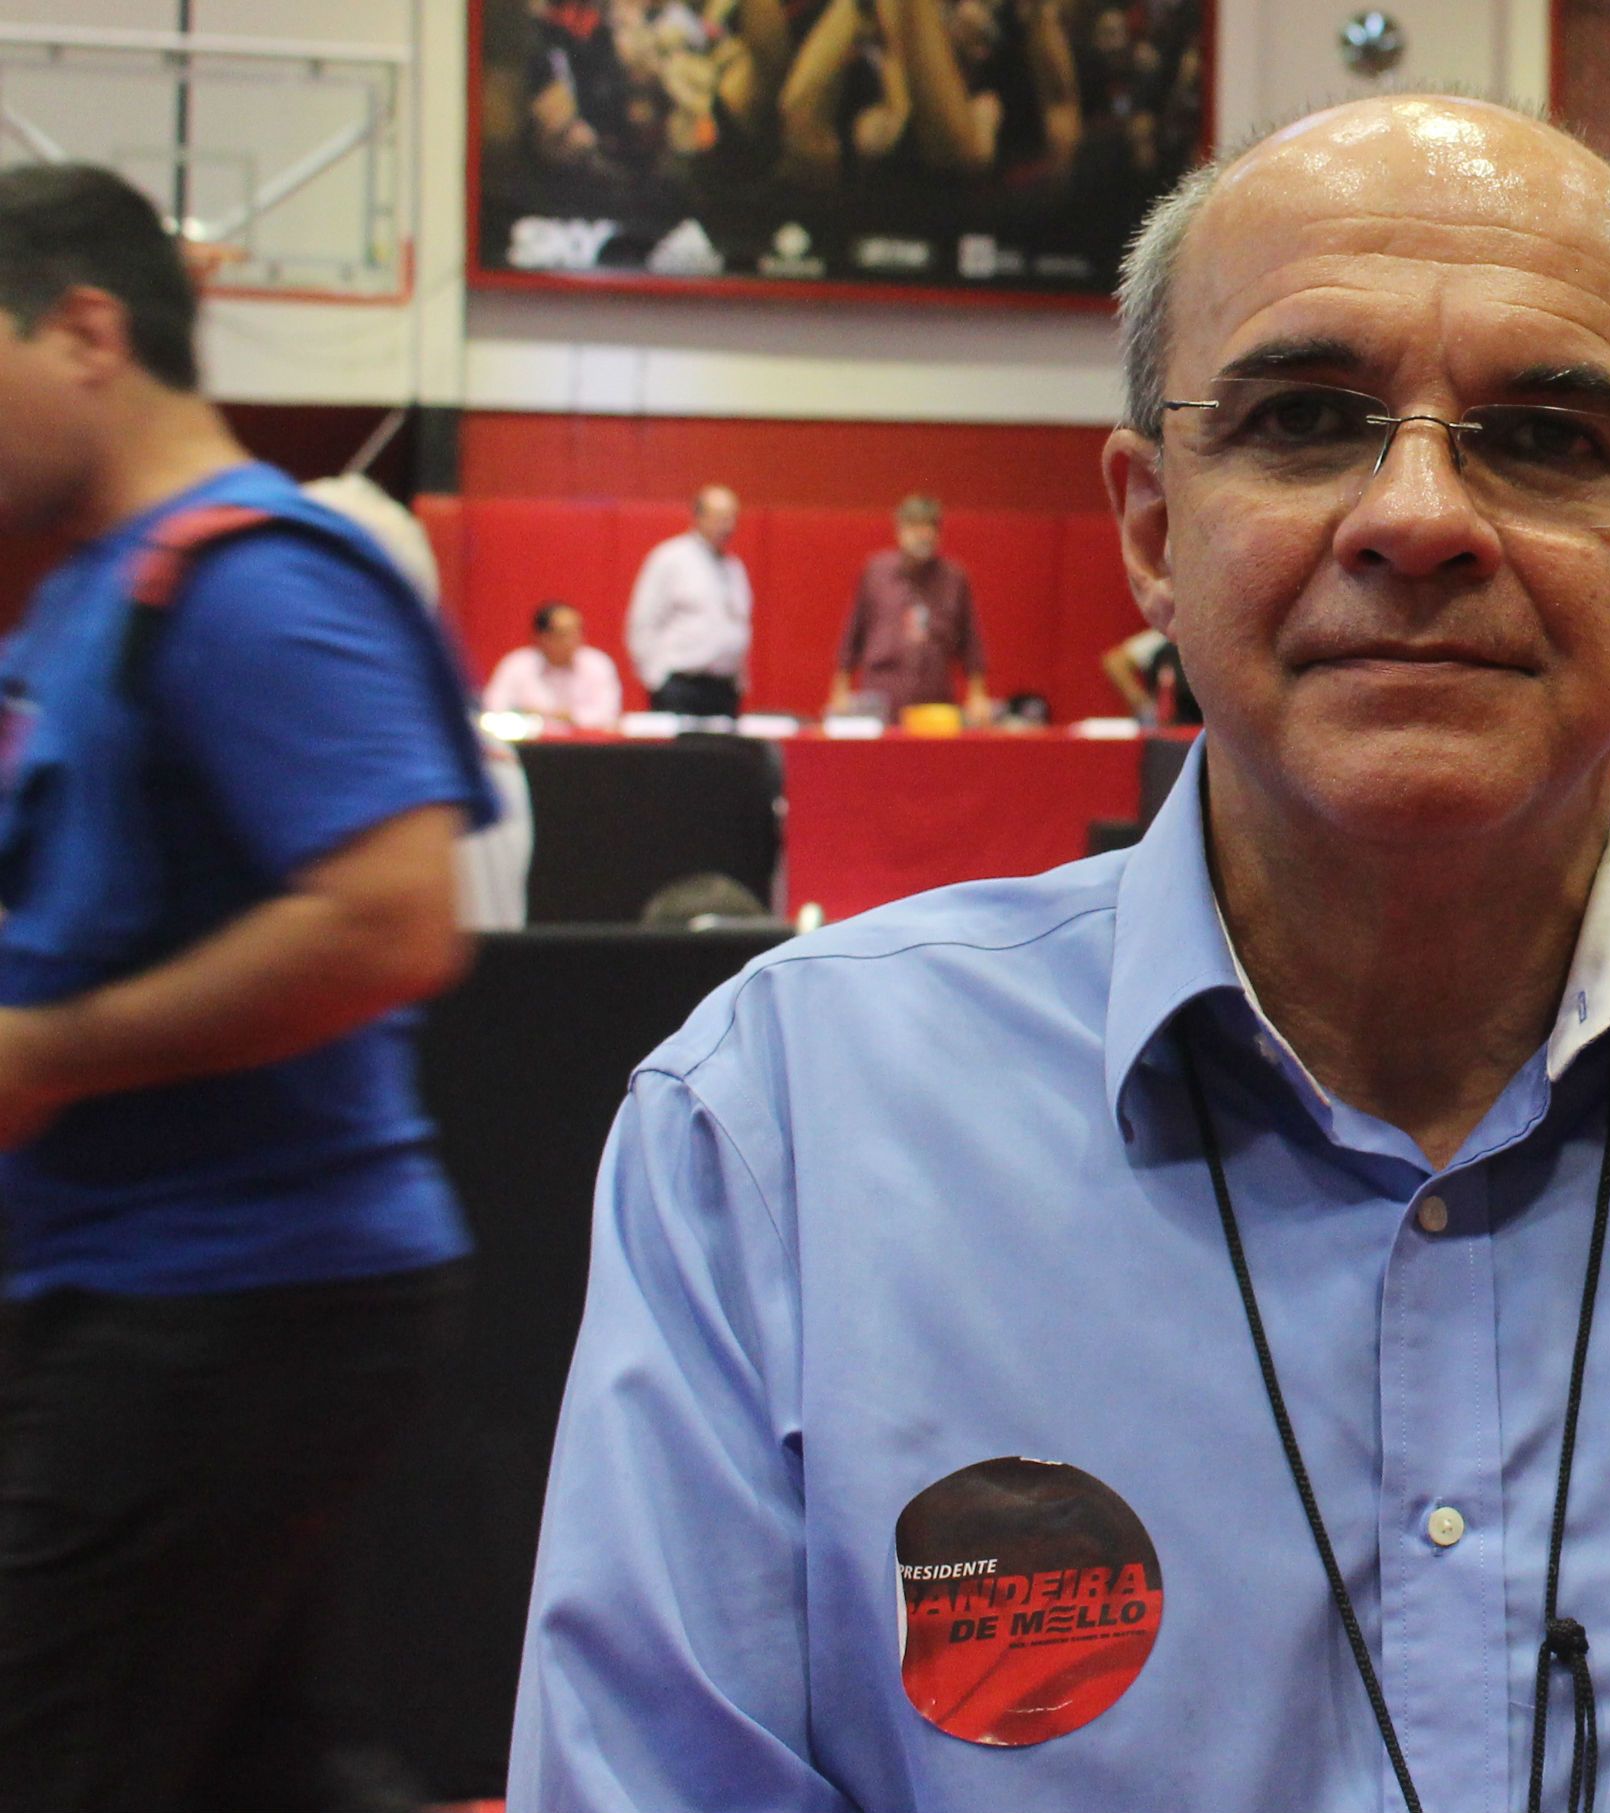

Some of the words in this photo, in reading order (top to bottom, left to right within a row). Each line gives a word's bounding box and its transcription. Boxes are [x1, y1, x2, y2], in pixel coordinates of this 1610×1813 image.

[898, 1558, 998, 1580] PRESIDENTE
[948, 1616, 998, 1644] DE
[1009, 1600, 1147, 1636] MELLO
